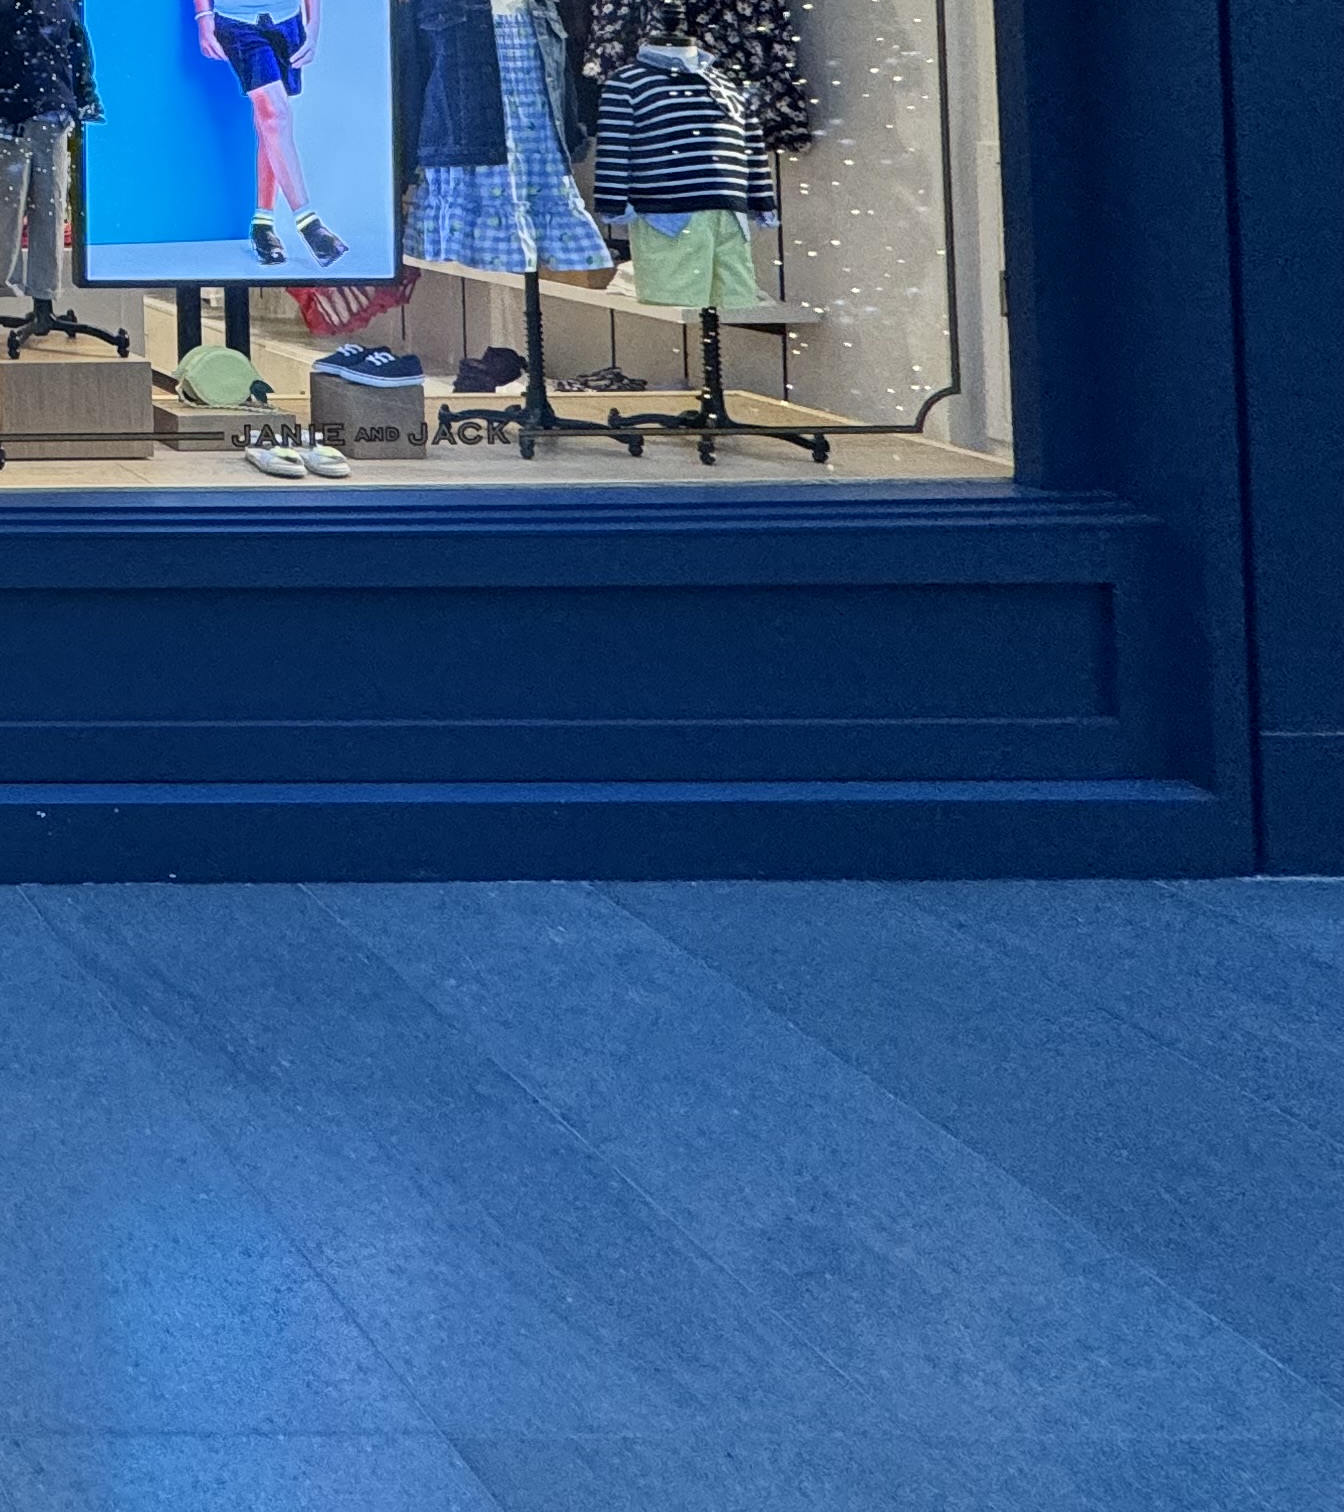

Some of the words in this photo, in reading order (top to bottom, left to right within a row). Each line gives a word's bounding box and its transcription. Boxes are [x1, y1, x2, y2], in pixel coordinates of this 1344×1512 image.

[231, 423, 346, 447] JANIE
[354, 426, 400, 442] AND
[408, 421, 511, 447] JACK
